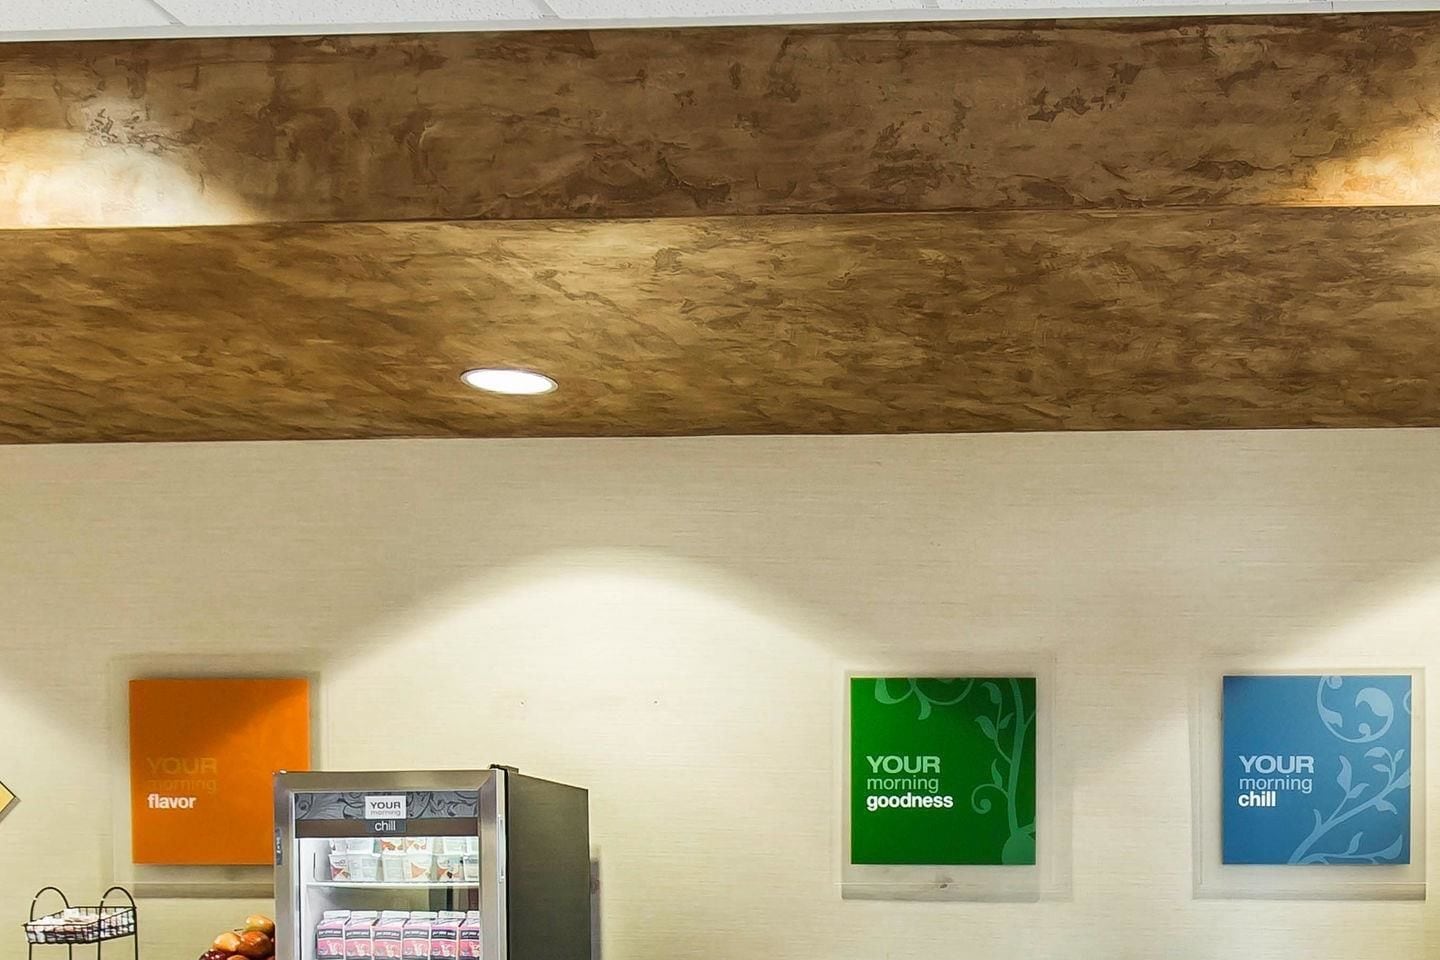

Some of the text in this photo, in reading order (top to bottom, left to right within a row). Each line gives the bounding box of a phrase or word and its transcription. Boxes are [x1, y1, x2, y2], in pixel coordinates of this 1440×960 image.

[146, 757, 217, 774] YOUR
[866, 755, 941, 774] YOUR
[1238, 755, 1315, 774] YOUR
[867, 774, 939, 794] morning
[1239, 775, 1313, 794] morning
[147, 793, 197, 809] flavor
[370, 801, 401, 809] YOUR
[866, 792, 954, 812] goodness
[1238, 790, 1276, 807] chill
[374, 820, 396, 831] chill
